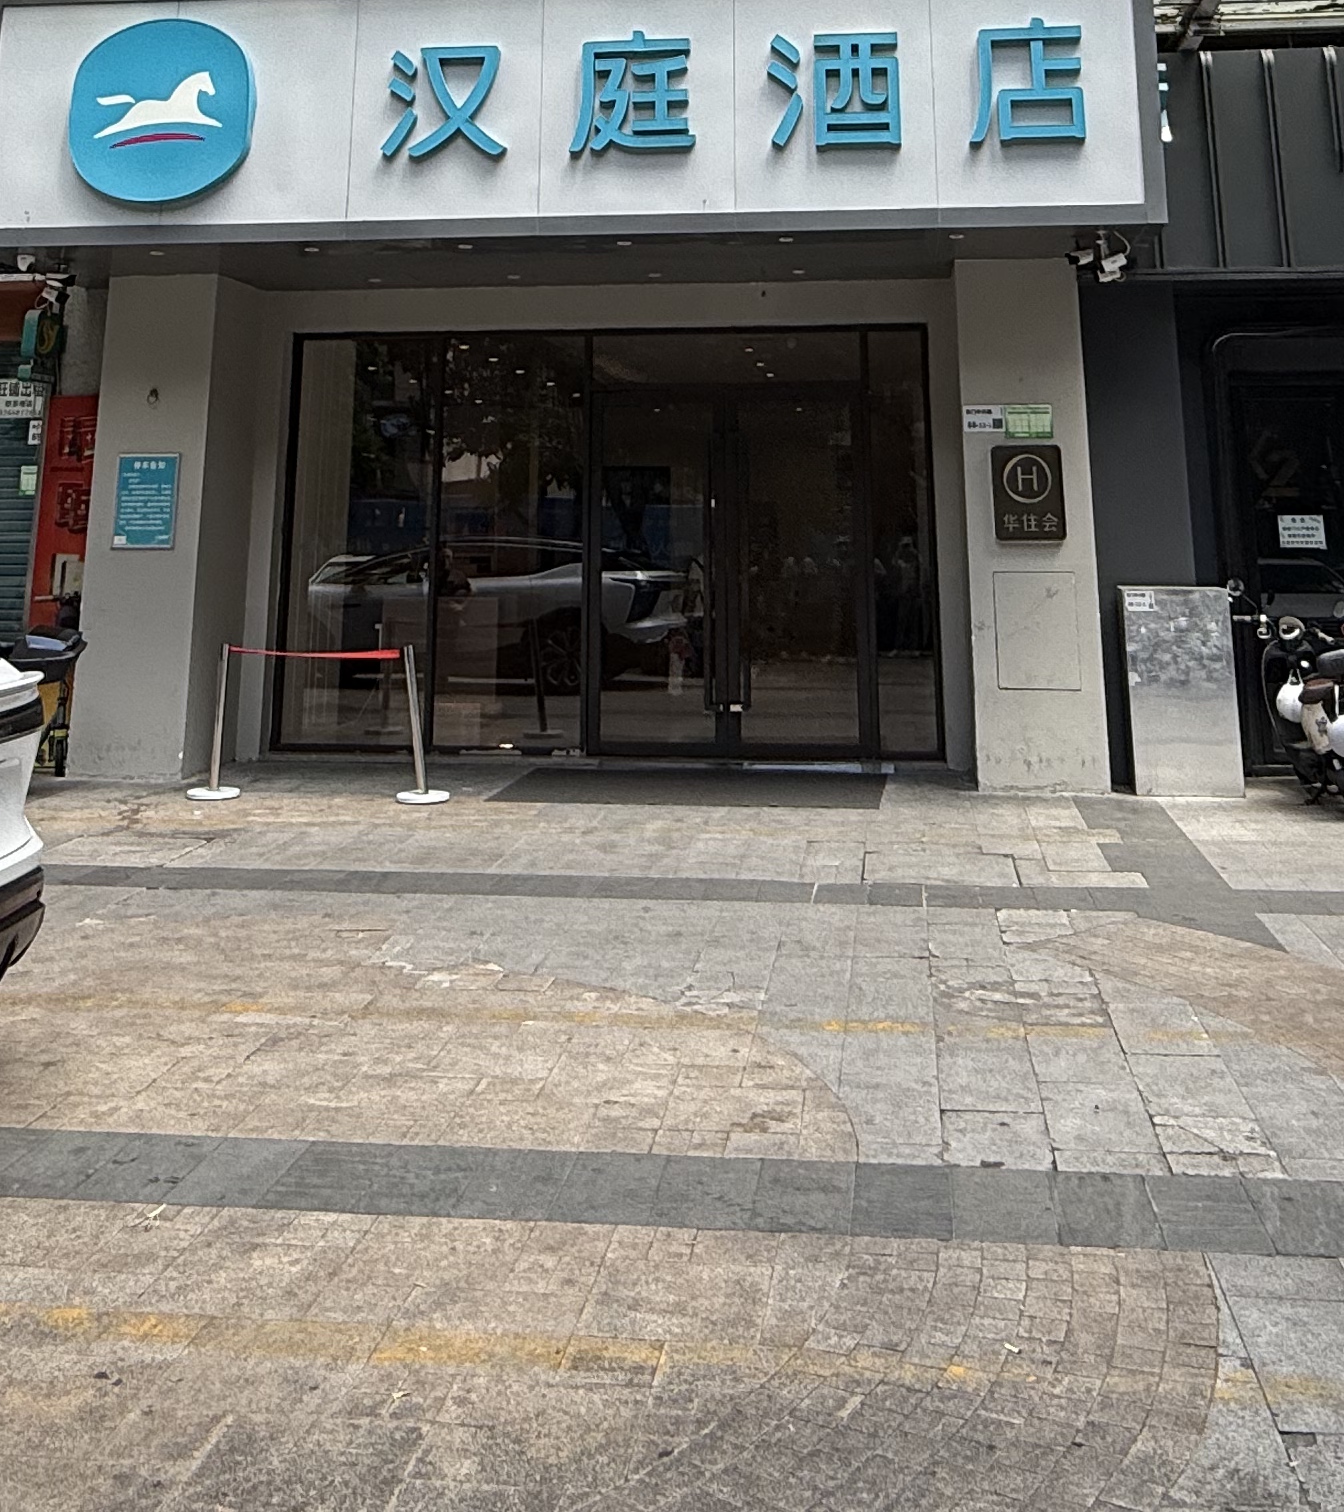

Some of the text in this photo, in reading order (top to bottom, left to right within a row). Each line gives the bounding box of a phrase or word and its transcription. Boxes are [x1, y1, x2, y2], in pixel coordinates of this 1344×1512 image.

[381, 18, 1088, 160] 汉庭酒店
[1003, 512, 1060, 533] 华住会
